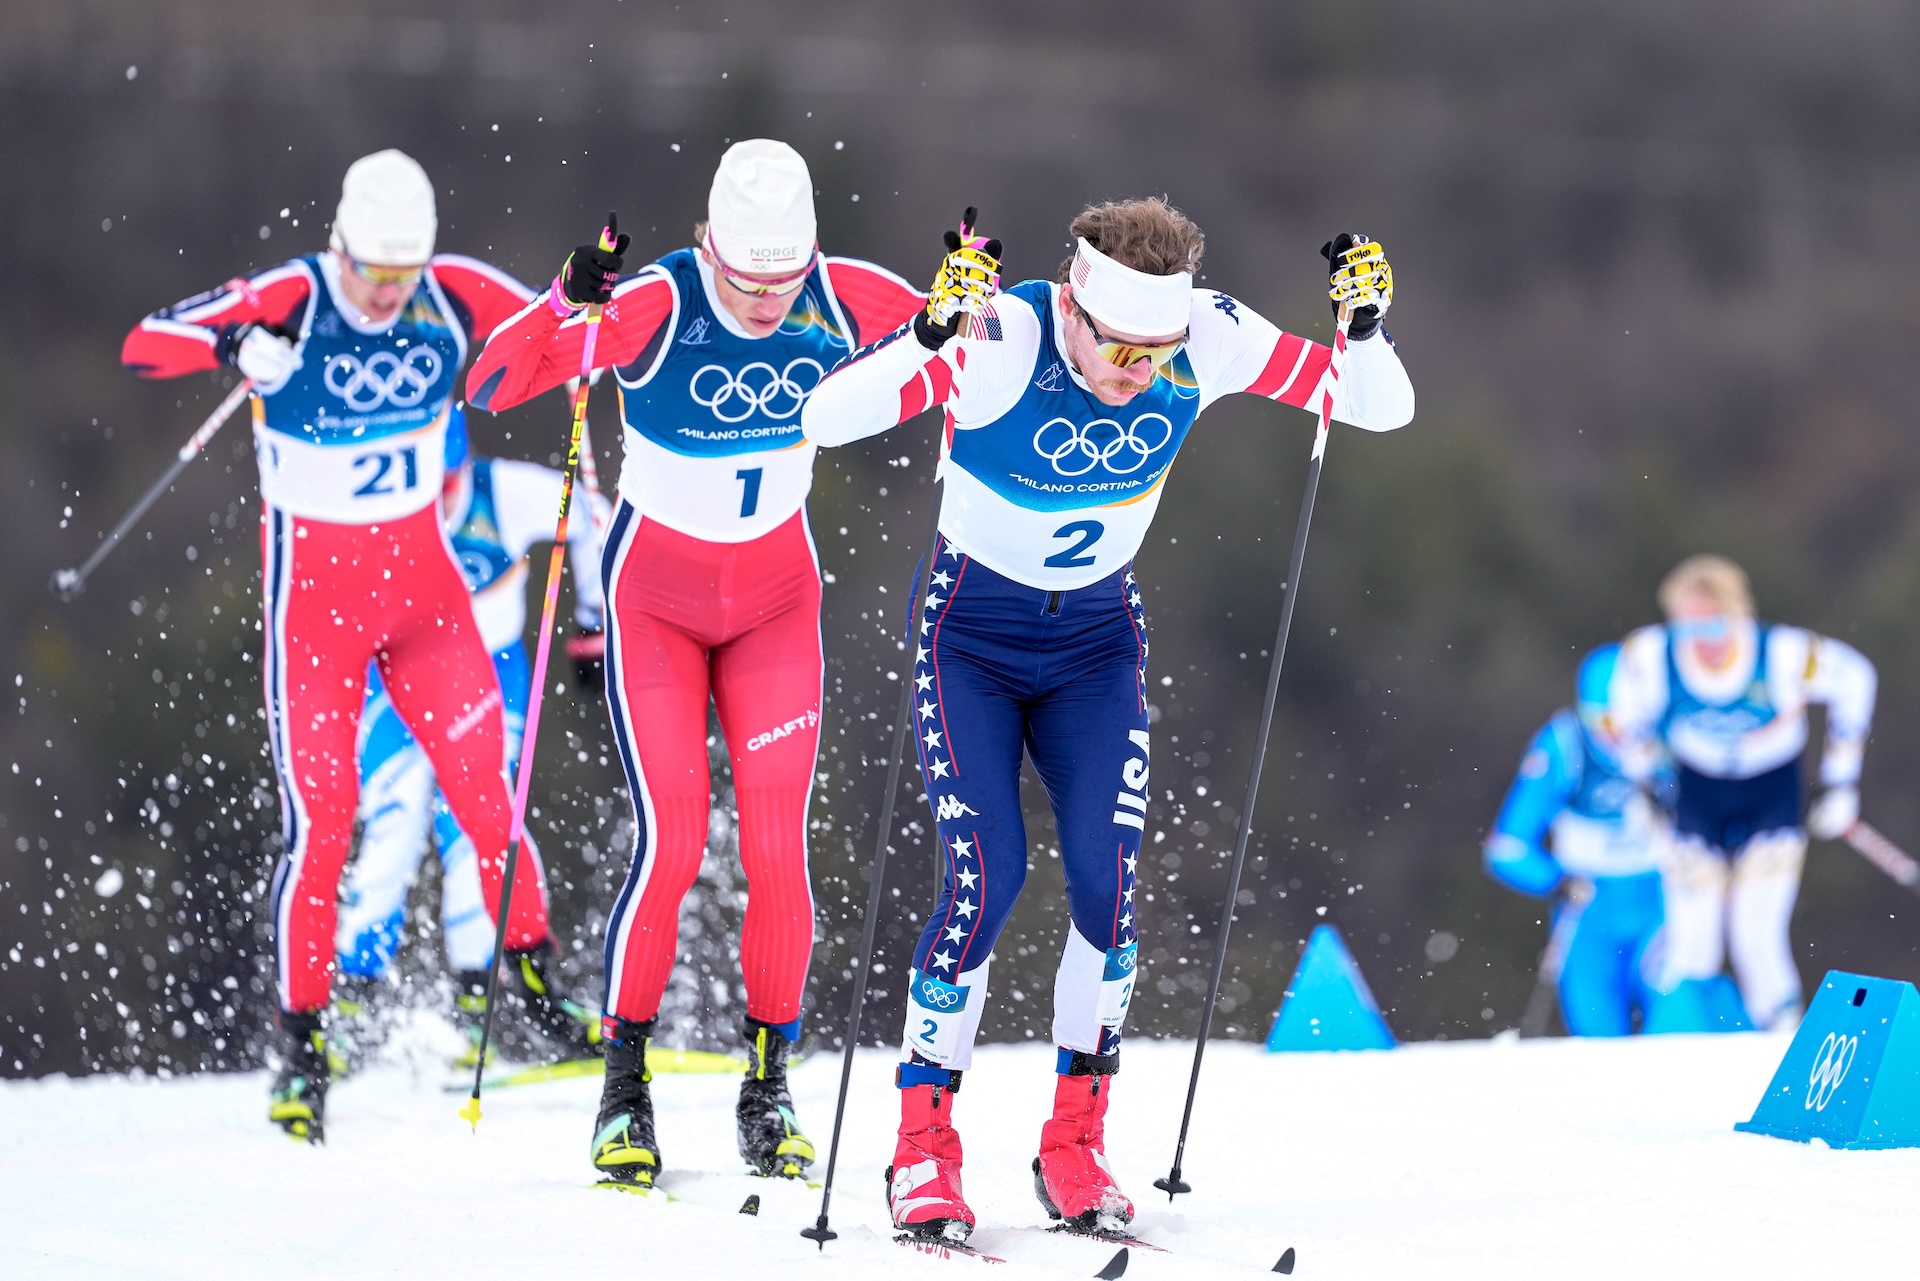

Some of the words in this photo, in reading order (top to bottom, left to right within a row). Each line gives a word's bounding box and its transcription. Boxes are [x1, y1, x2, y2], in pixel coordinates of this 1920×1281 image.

[750, 246, 798, 257] NORGE
[567, 401, 588, 466] LEKI
[677, 427, 739, 441] MILANO
[741, 424, 801, 438] CORTINA
[353, 445, 418, 498] 21
[1009, 473, 1074, 493] MILANO
[1076, 479, 1142, 493] CORTINA
[736, 467, 763, 518] 1
[1043, 519, 1105, 568] 2
[746, 715, 807, 752] CRAFT
[1112, 729, 1150, 833] USA
[1120, 982, 1131, 1008] 2
[919, 1018, 938, 1044] 2
